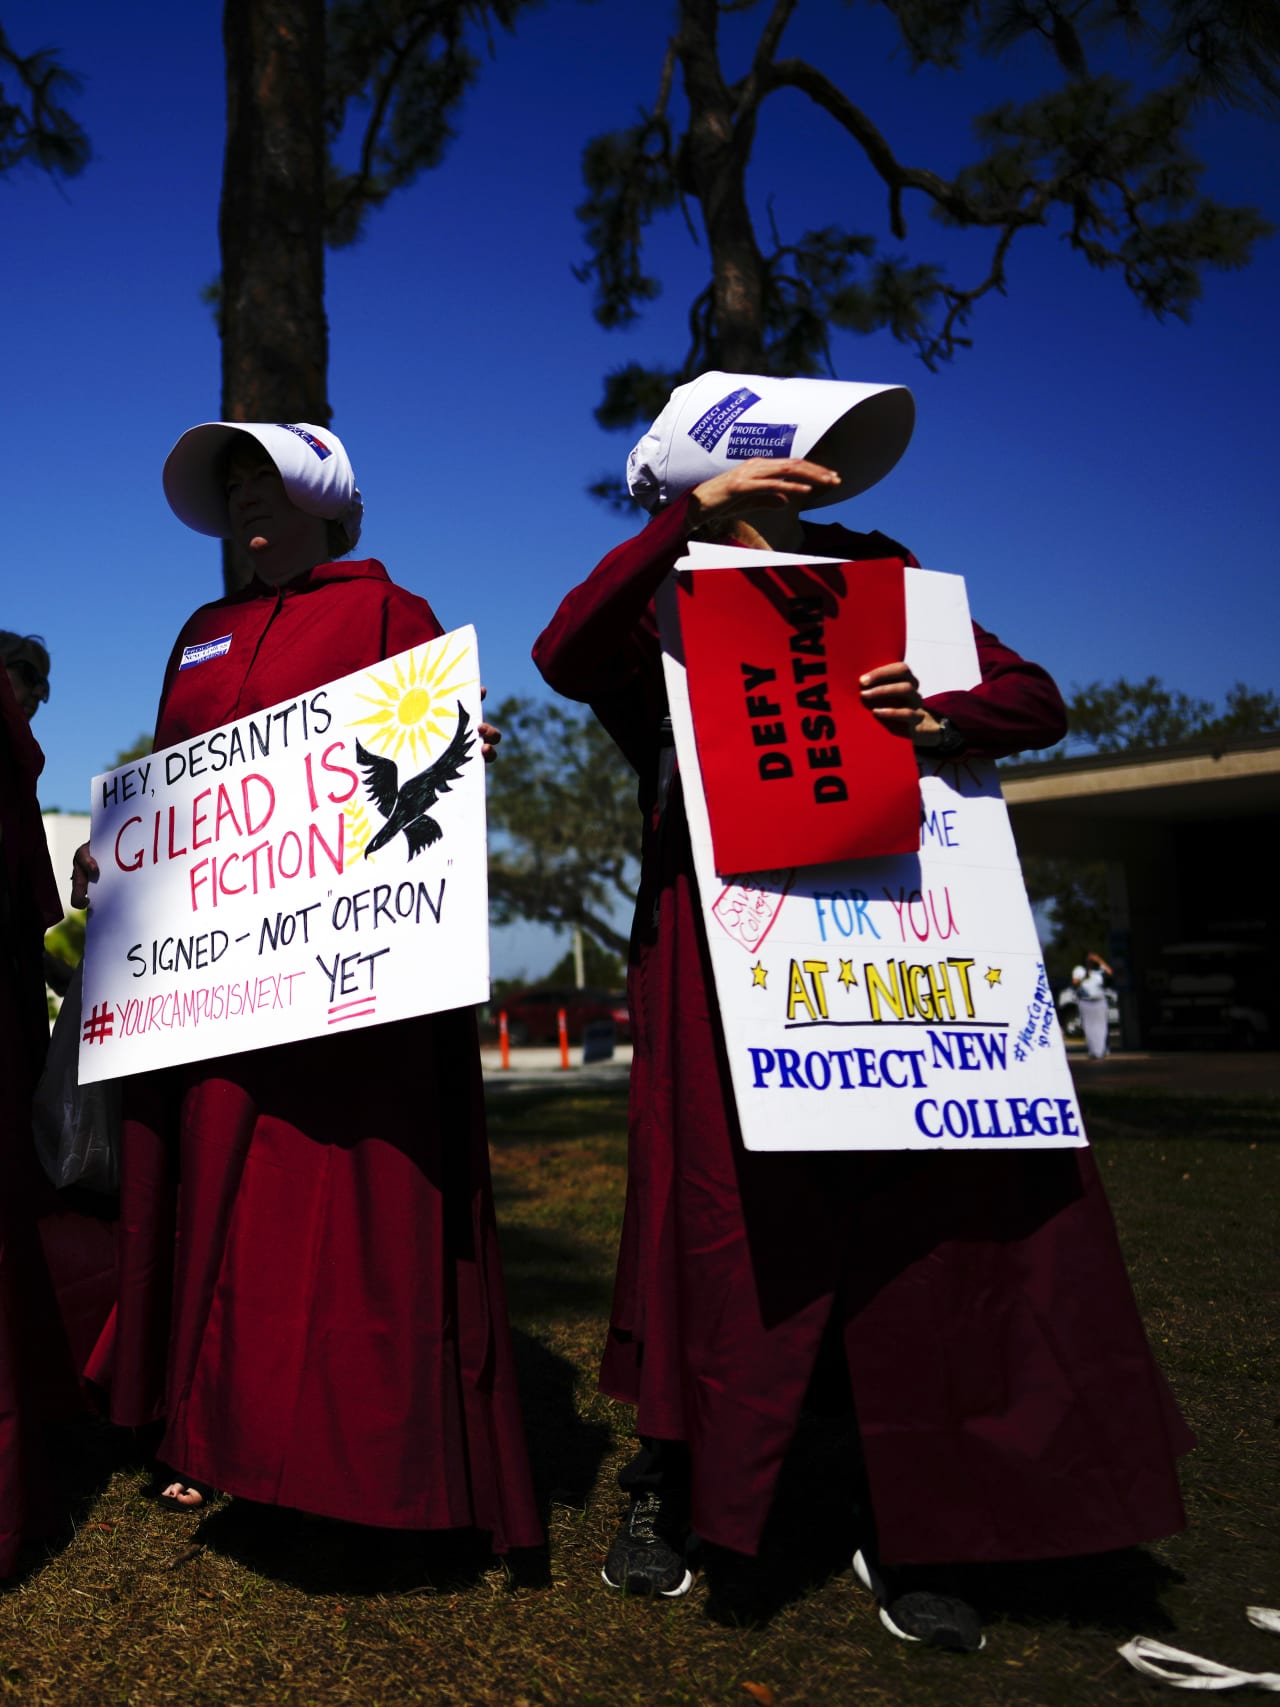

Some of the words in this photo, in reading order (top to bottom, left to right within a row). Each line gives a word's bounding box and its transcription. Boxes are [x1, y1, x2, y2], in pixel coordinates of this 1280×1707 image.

[691, 406, 721, 438] PROTECT
[697, 424, 714, 445] NEW
[713, 396, 746, 425] COLLEGE
[704, 441, 715, 450] OF
[713, 406, 745, 438] FLORIDA
[728, 437, 748, 446] NEW
[749, 437, 785, 447] COLLEGE
[731, 426, 767, 435] PROTECT
[727, 447, 739, 456] OF
[740, 448, 774, 457] FLORIDA
[741, 662, 793, 781] DEFY
[789, 595, 848, 804] DESATAN
[103, 762, 155, 808] HEY,
[165, 691, 332, 786] DESANTIS
[115, 773, 275, 872] GILEAD
[304, 741, 359, 812] IS
[189, 813, 345, 912] FICTION
[127, 930, 229, 977] SIGNED
[258, 902, 322, 955] NOT
[815, 889, 881, 941] FOR
[882, 886, 960, 943] YOU
[316, 947, 390, 1002] YET
[786, 958, 829, 1020] AT
[864, 957, 976, 1023] NIGHT
[82, 971, 306, 1045] #YOURCAMPUSISNEXT
[748, 1048, 929, 1091] PROTECT
[926, 1030, 1008, 1071] NEW
[914, 1097, 1080, 1140] COLLEGE
